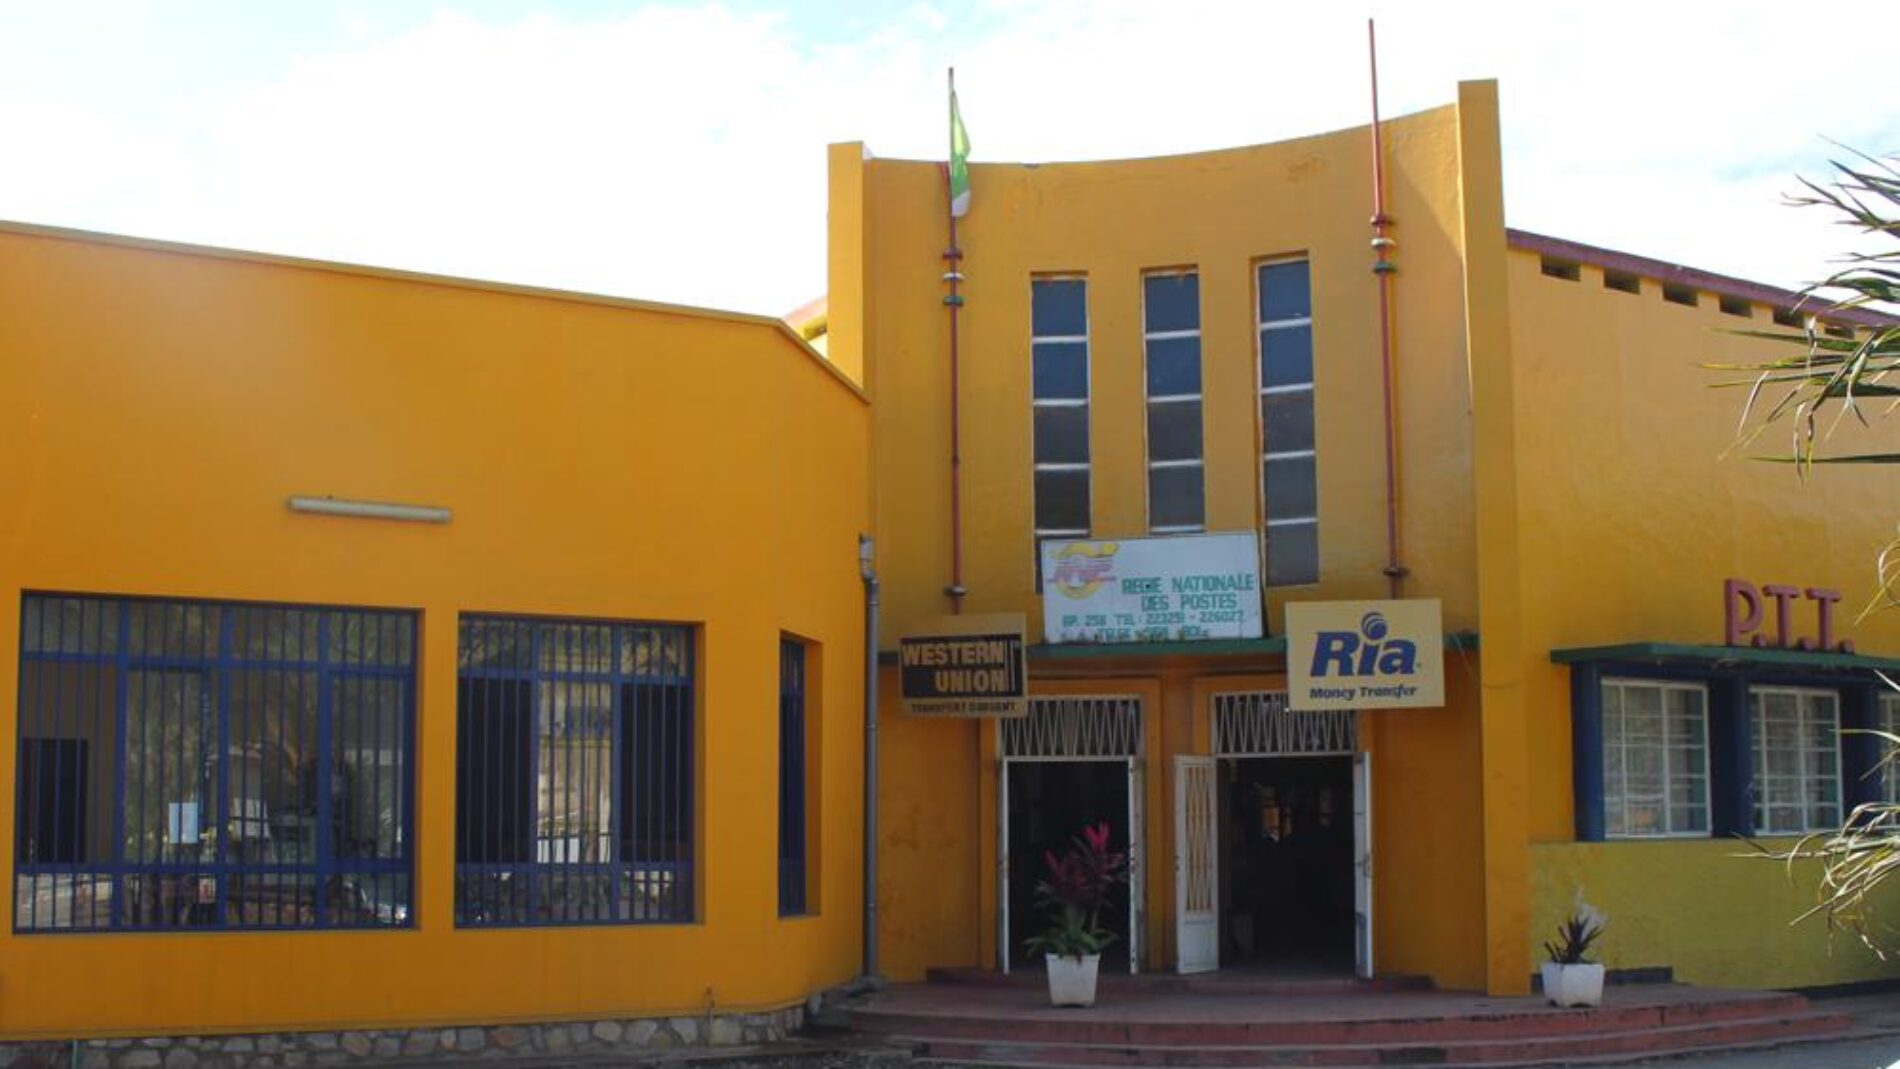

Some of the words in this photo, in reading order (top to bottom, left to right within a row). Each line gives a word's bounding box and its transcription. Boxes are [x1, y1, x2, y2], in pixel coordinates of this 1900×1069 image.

[1171, 573, 1254, 592] NATIONALE
[1141, 595, 1169, 611] DES
[1181, 593, 1237, 610] POSTES
[1724, 578, 1855, 654] P.T.T.
[902, 640, 1004, 667] WESTERN
[1310, 612, 1417, 677] Ria
[935, 669, 1006, 692] UNION
[1310, 687, 1356, 701] Money
[1360, 684, 1418, 698] Transfer
